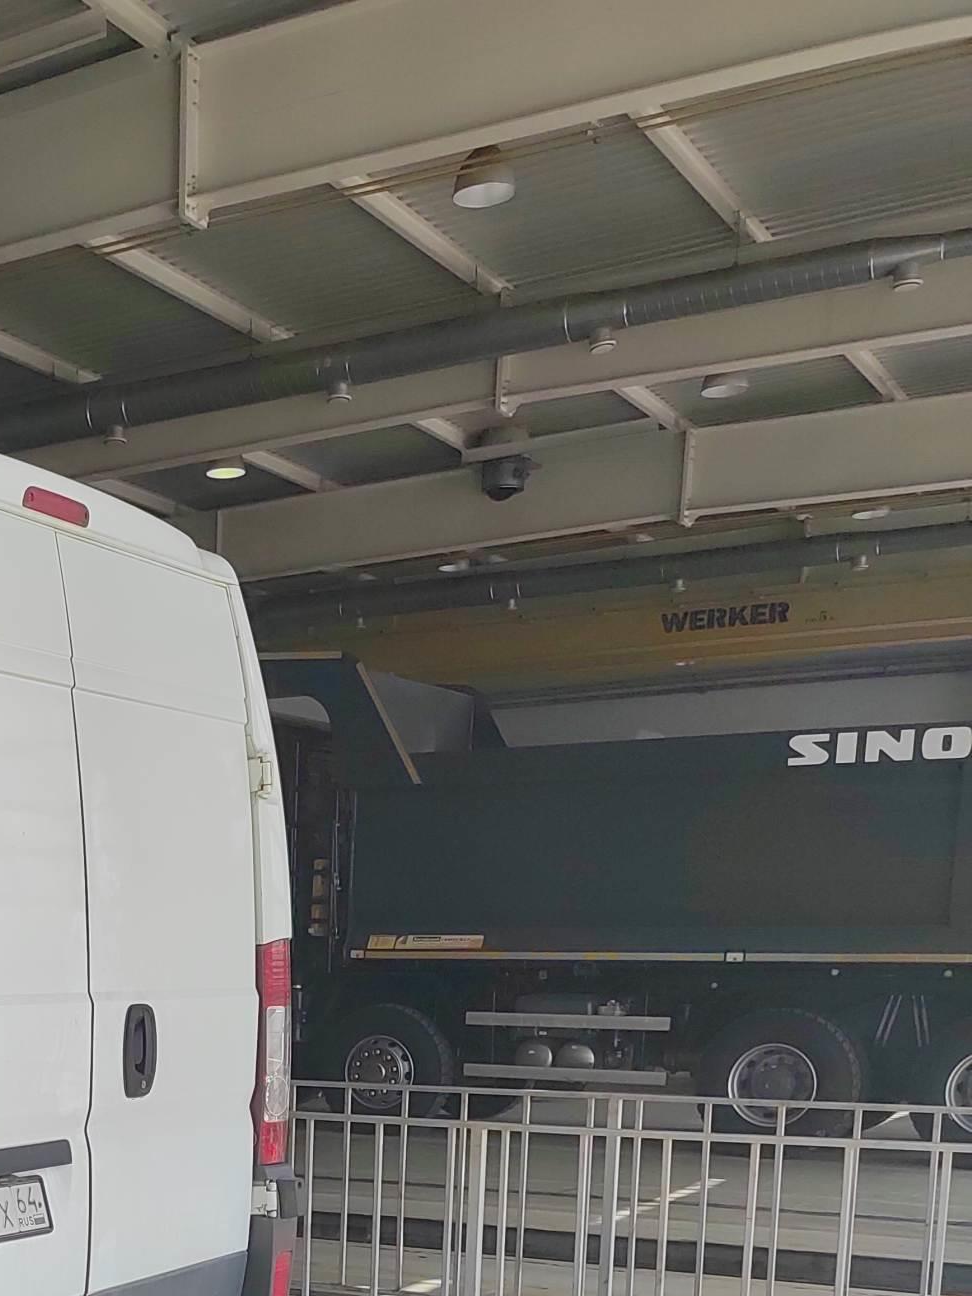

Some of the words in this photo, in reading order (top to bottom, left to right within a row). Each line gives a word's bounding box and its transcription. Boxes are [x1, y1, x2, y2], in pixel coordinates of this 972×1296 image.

[661, 602, 790, 634] WERKER
[787, 726, 972, 767] SINO
[17, 1187, 38, 1214] 64
[18, 1216, 35, 1228] RUS
